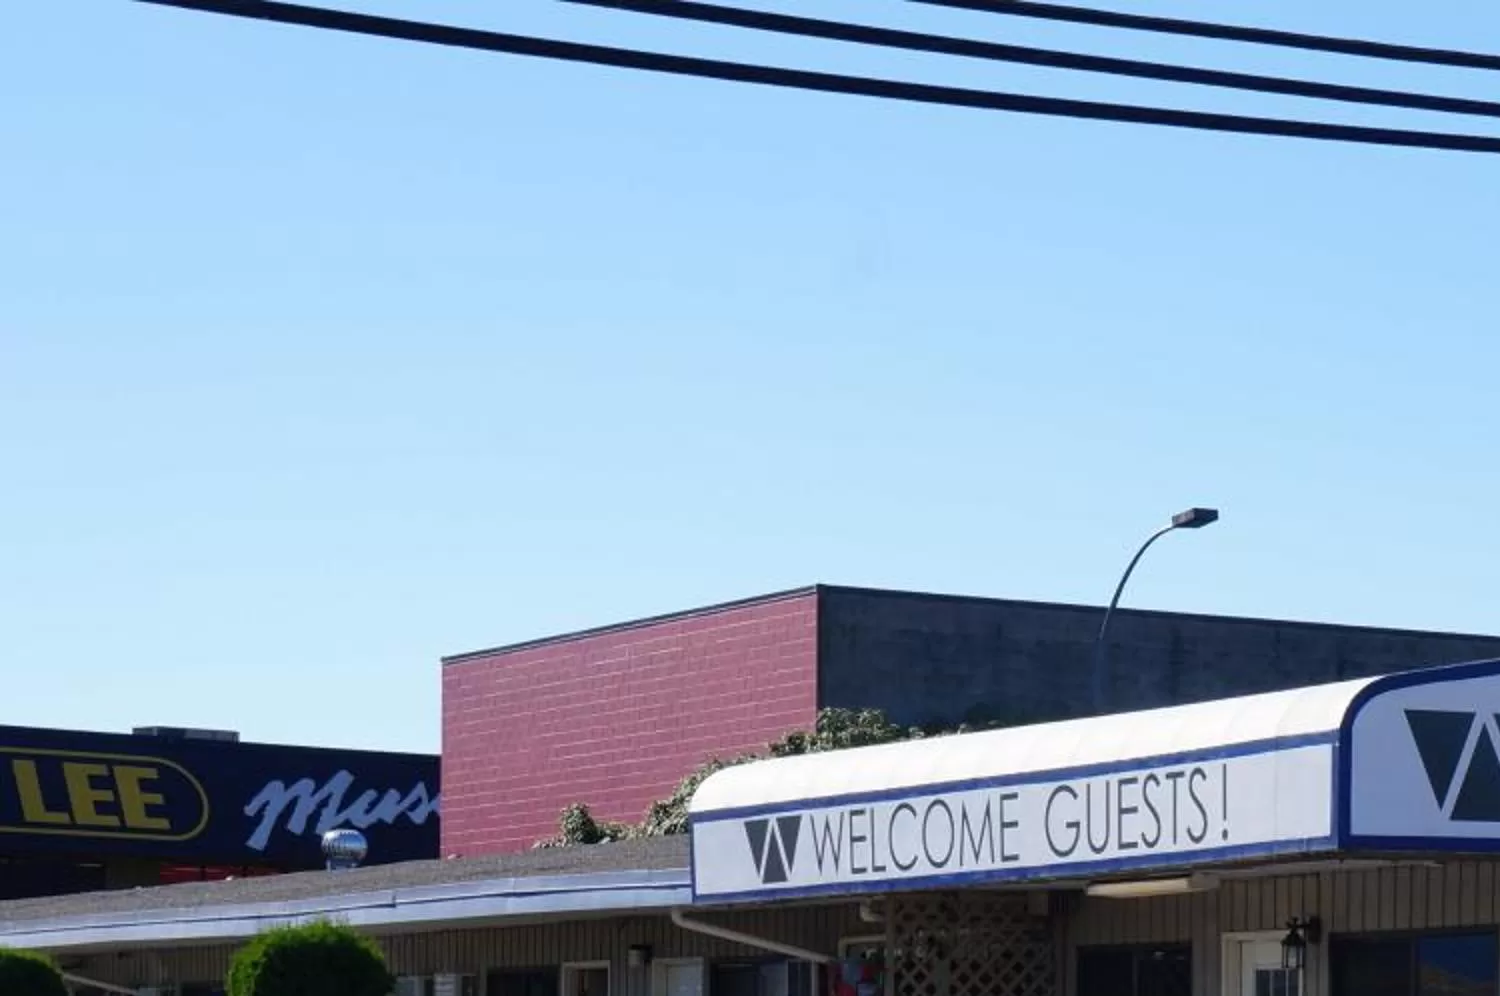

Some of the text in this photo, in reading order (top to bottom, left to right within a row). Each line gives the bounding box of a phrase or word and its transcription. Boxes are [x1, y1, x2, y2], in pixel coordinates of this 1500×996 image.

[12, 759, 172, 831] LEE
[244, 769, 442, 852] Mus
[809, 762, 1229, 877] WELCOME GUESTS!
